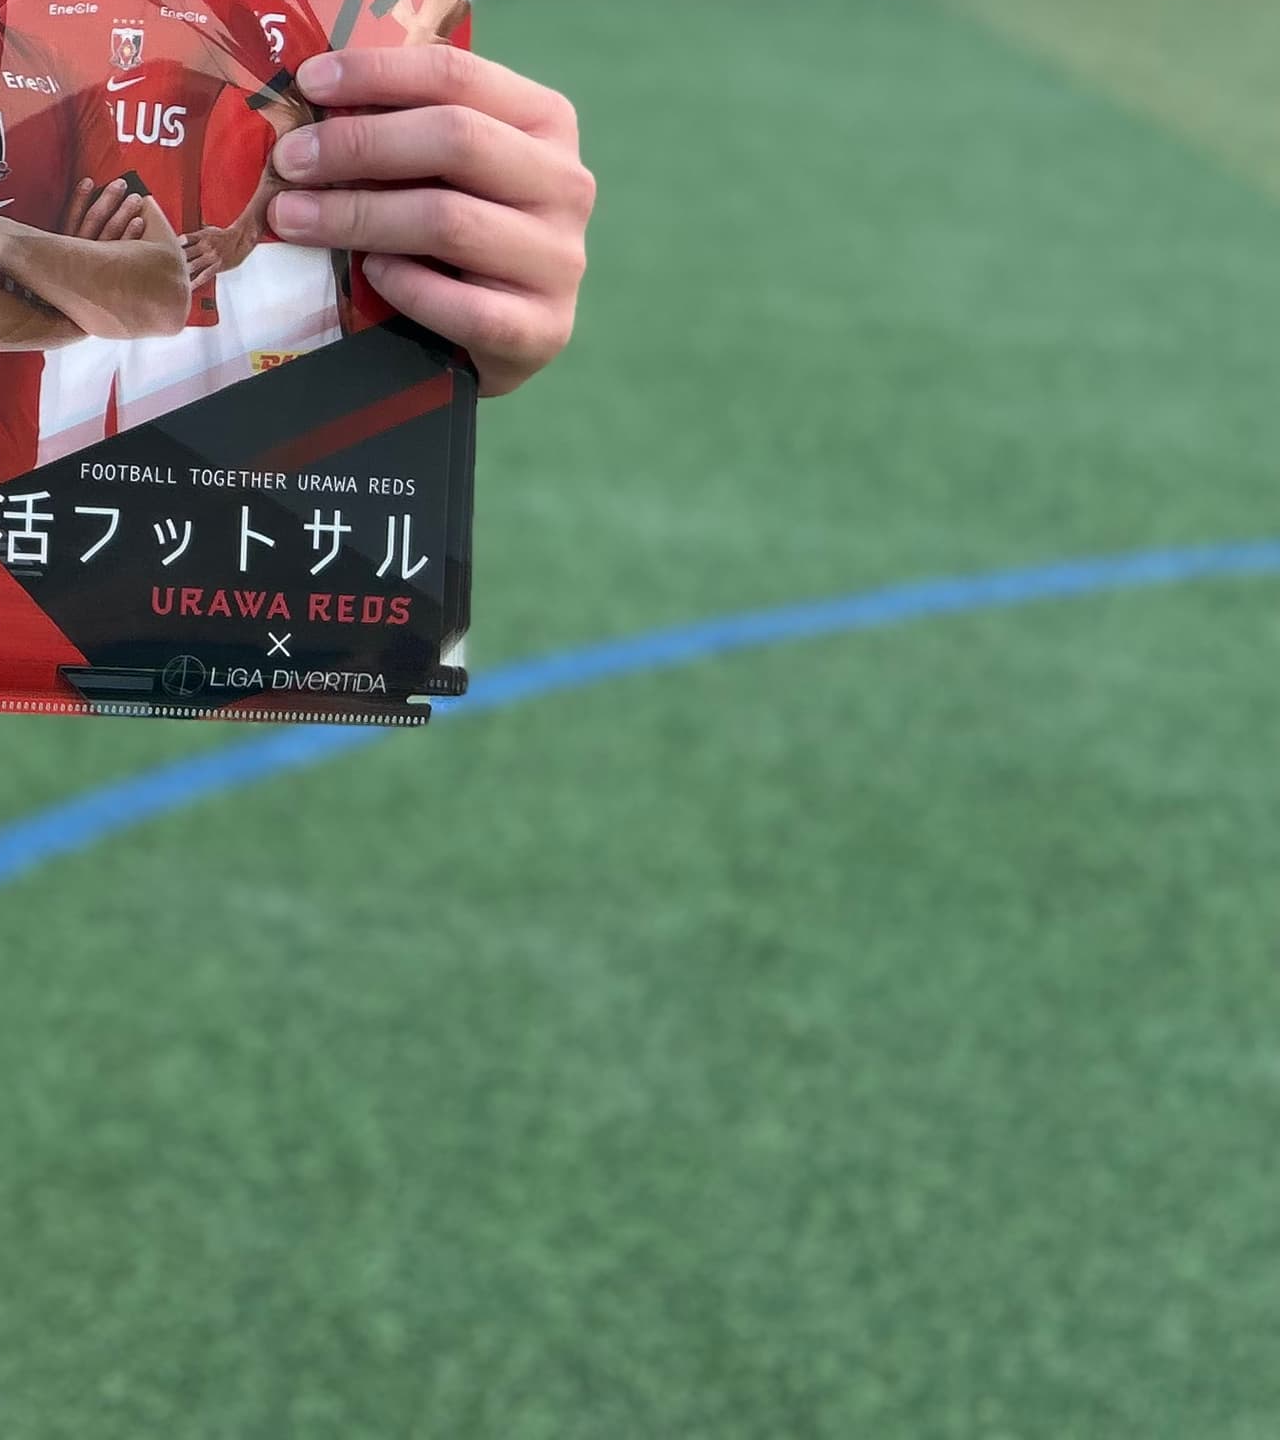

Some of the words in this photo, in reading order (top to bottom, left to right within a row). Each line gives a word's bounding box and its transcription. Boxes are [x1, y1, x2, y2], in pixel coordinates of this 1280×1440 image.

[106, 99, 186, 147] LUS
[80, 463, 177, 485] FOOTBALL
[189, 468, 288, 490] TOGETHER
[298, 474, 358, 493] URAWA
[369, 477, 416, 496] REDS
[151, 586, 291, 620] URAWA
[307, 592, 413, 624] REDS
